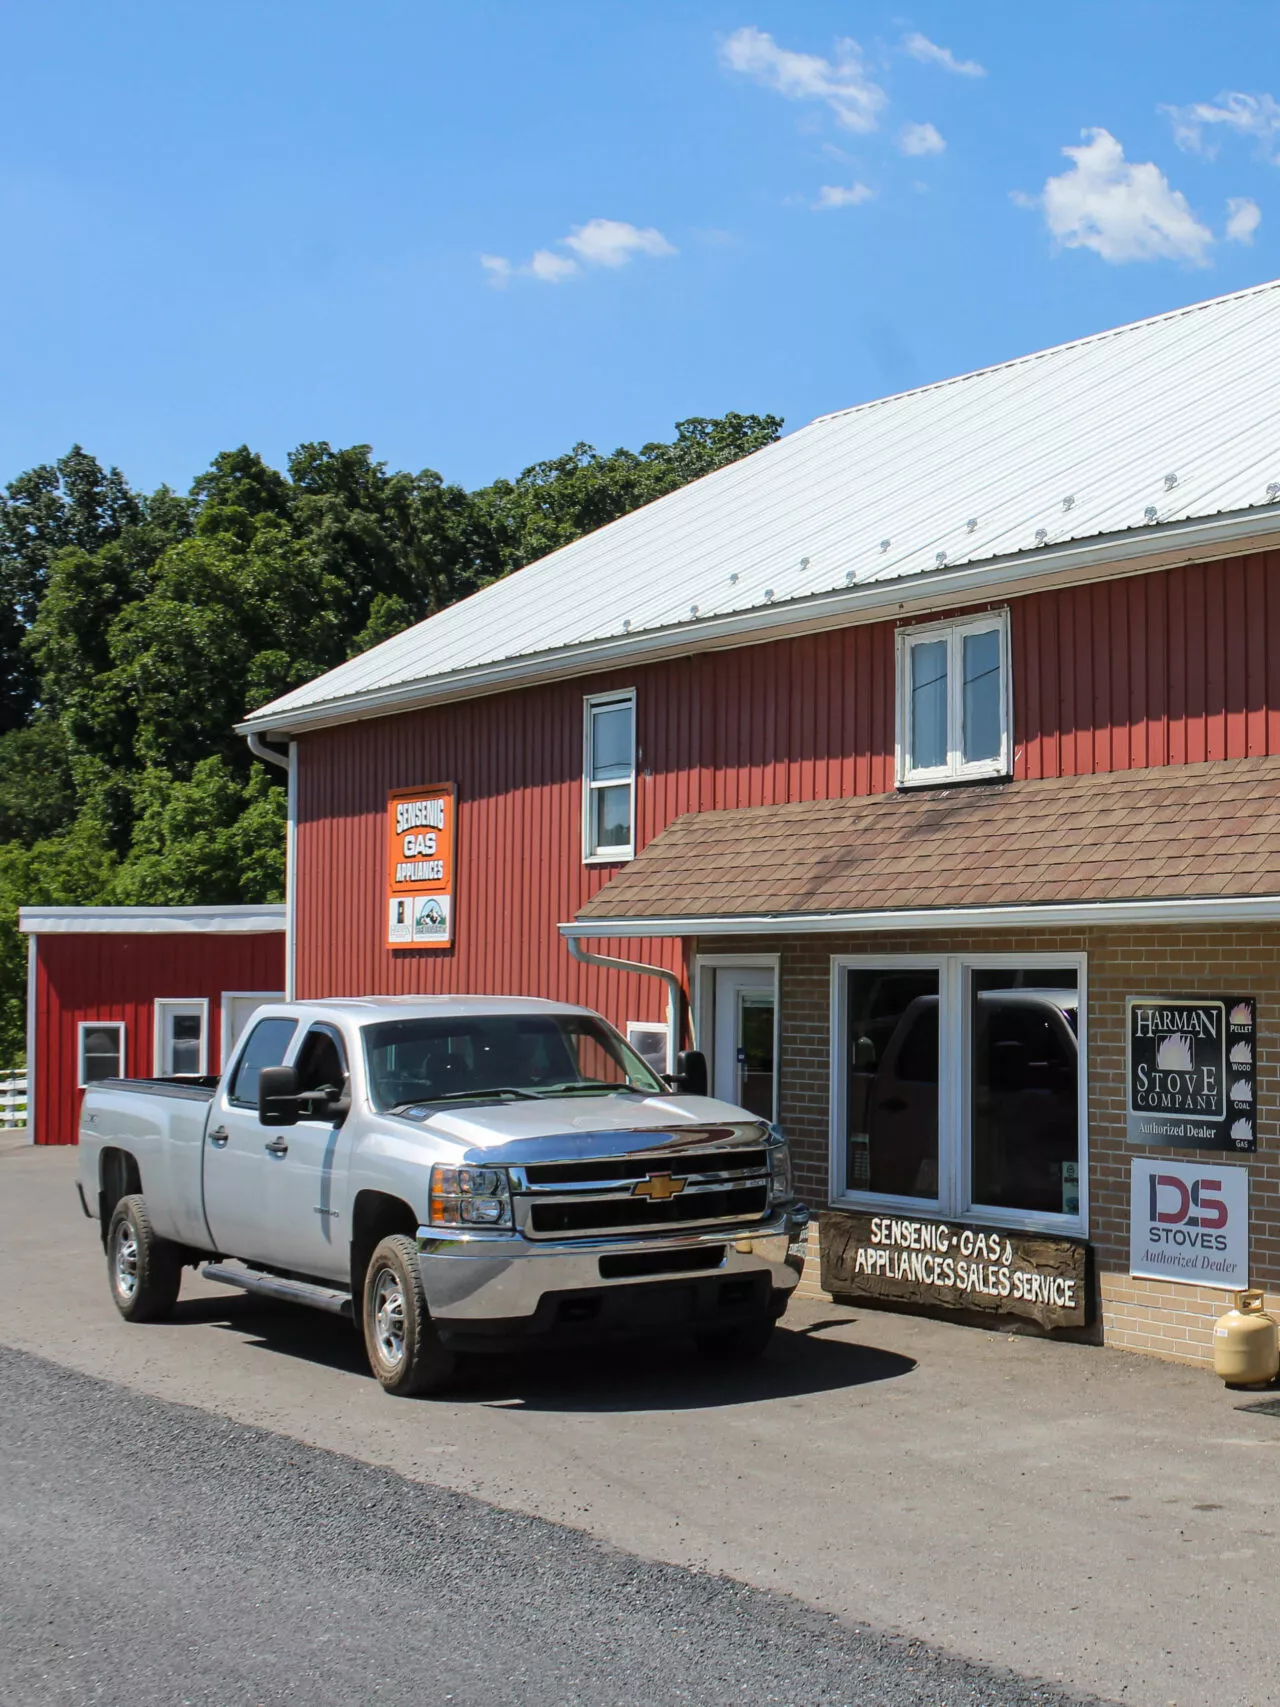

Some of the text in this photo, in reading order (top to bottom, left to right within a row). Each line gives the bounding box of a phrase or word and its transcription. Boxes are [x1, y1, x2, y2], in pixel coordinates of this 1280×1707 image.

[396, 799, 444, 834] SENSENIG
[403, 832, 436, 857] GAS
[395, 860, 443, 883] APPLIANCES
[1135, 1009, 1218, 1038] HARMAN
[1230, 1025, 1252, 1033] PELLET
[1137, 1063, 1217, 1095] STOVE
[1232, 1063, 1251, 1071] WOOD
[1138, 1092, 1217, 1110] COMPANY
[1234, 1101, 1250, 1109] COAL
[1139, 1122, 1216, 1138] Authorized Dealer
[1236, 1140, 1248, 1148] GAS
[1149, 1174, 1228, 1229] DS
[871, 1217, 1000, 1261] SENSENIG GAS
[1149, 1227, 1228, 1251] STOVES
[1141, 1249, 1238, 1273] Authorized Dealer
[855, 1248, 1076, 1308] APPLIANCES SALES SERVICE
